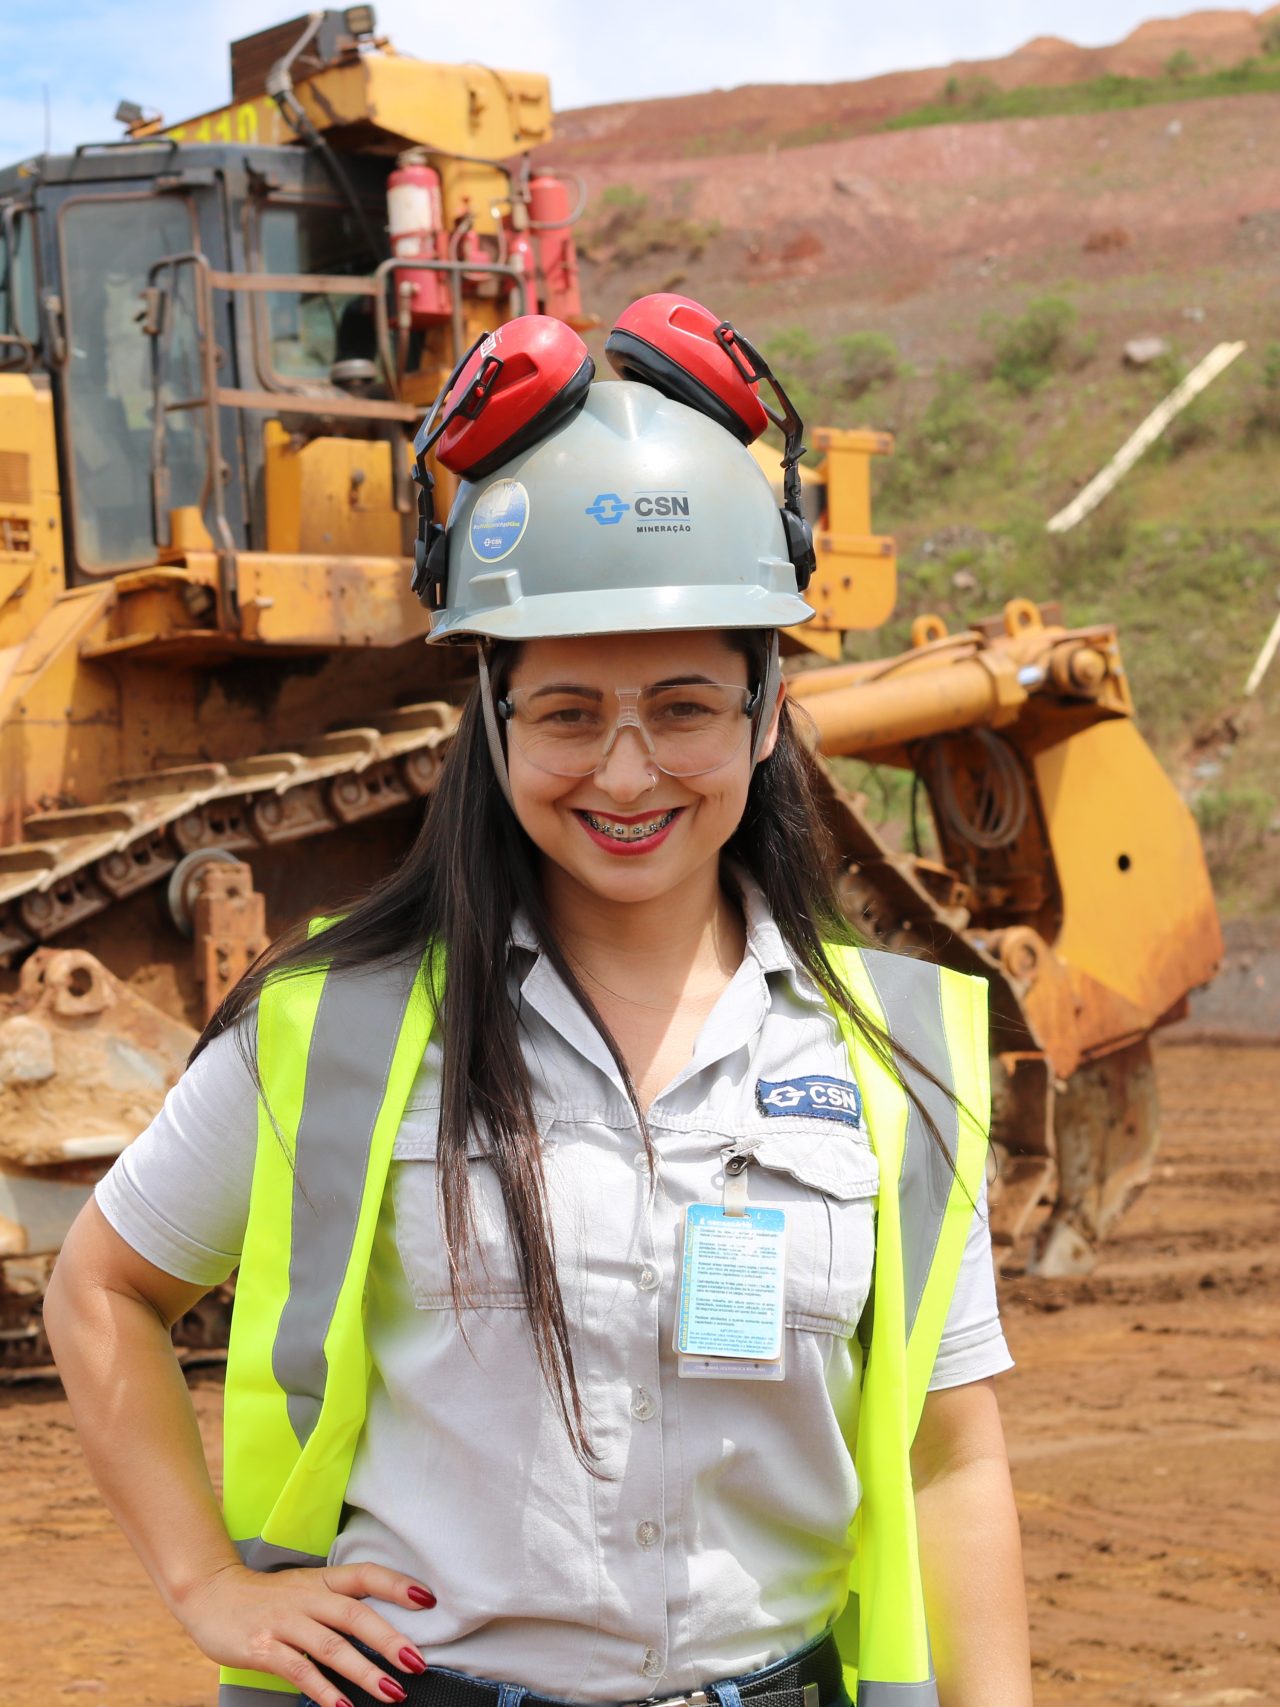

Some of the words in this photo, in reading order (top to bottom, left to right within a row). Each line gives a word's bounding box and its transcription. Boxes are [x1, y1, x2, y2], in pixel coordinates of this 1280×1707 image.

[635, 496, 689, 516] CSN
[637, 524, 691, 533] MINERAÇÃO
[810, 1086, 856, 1111] CSN
